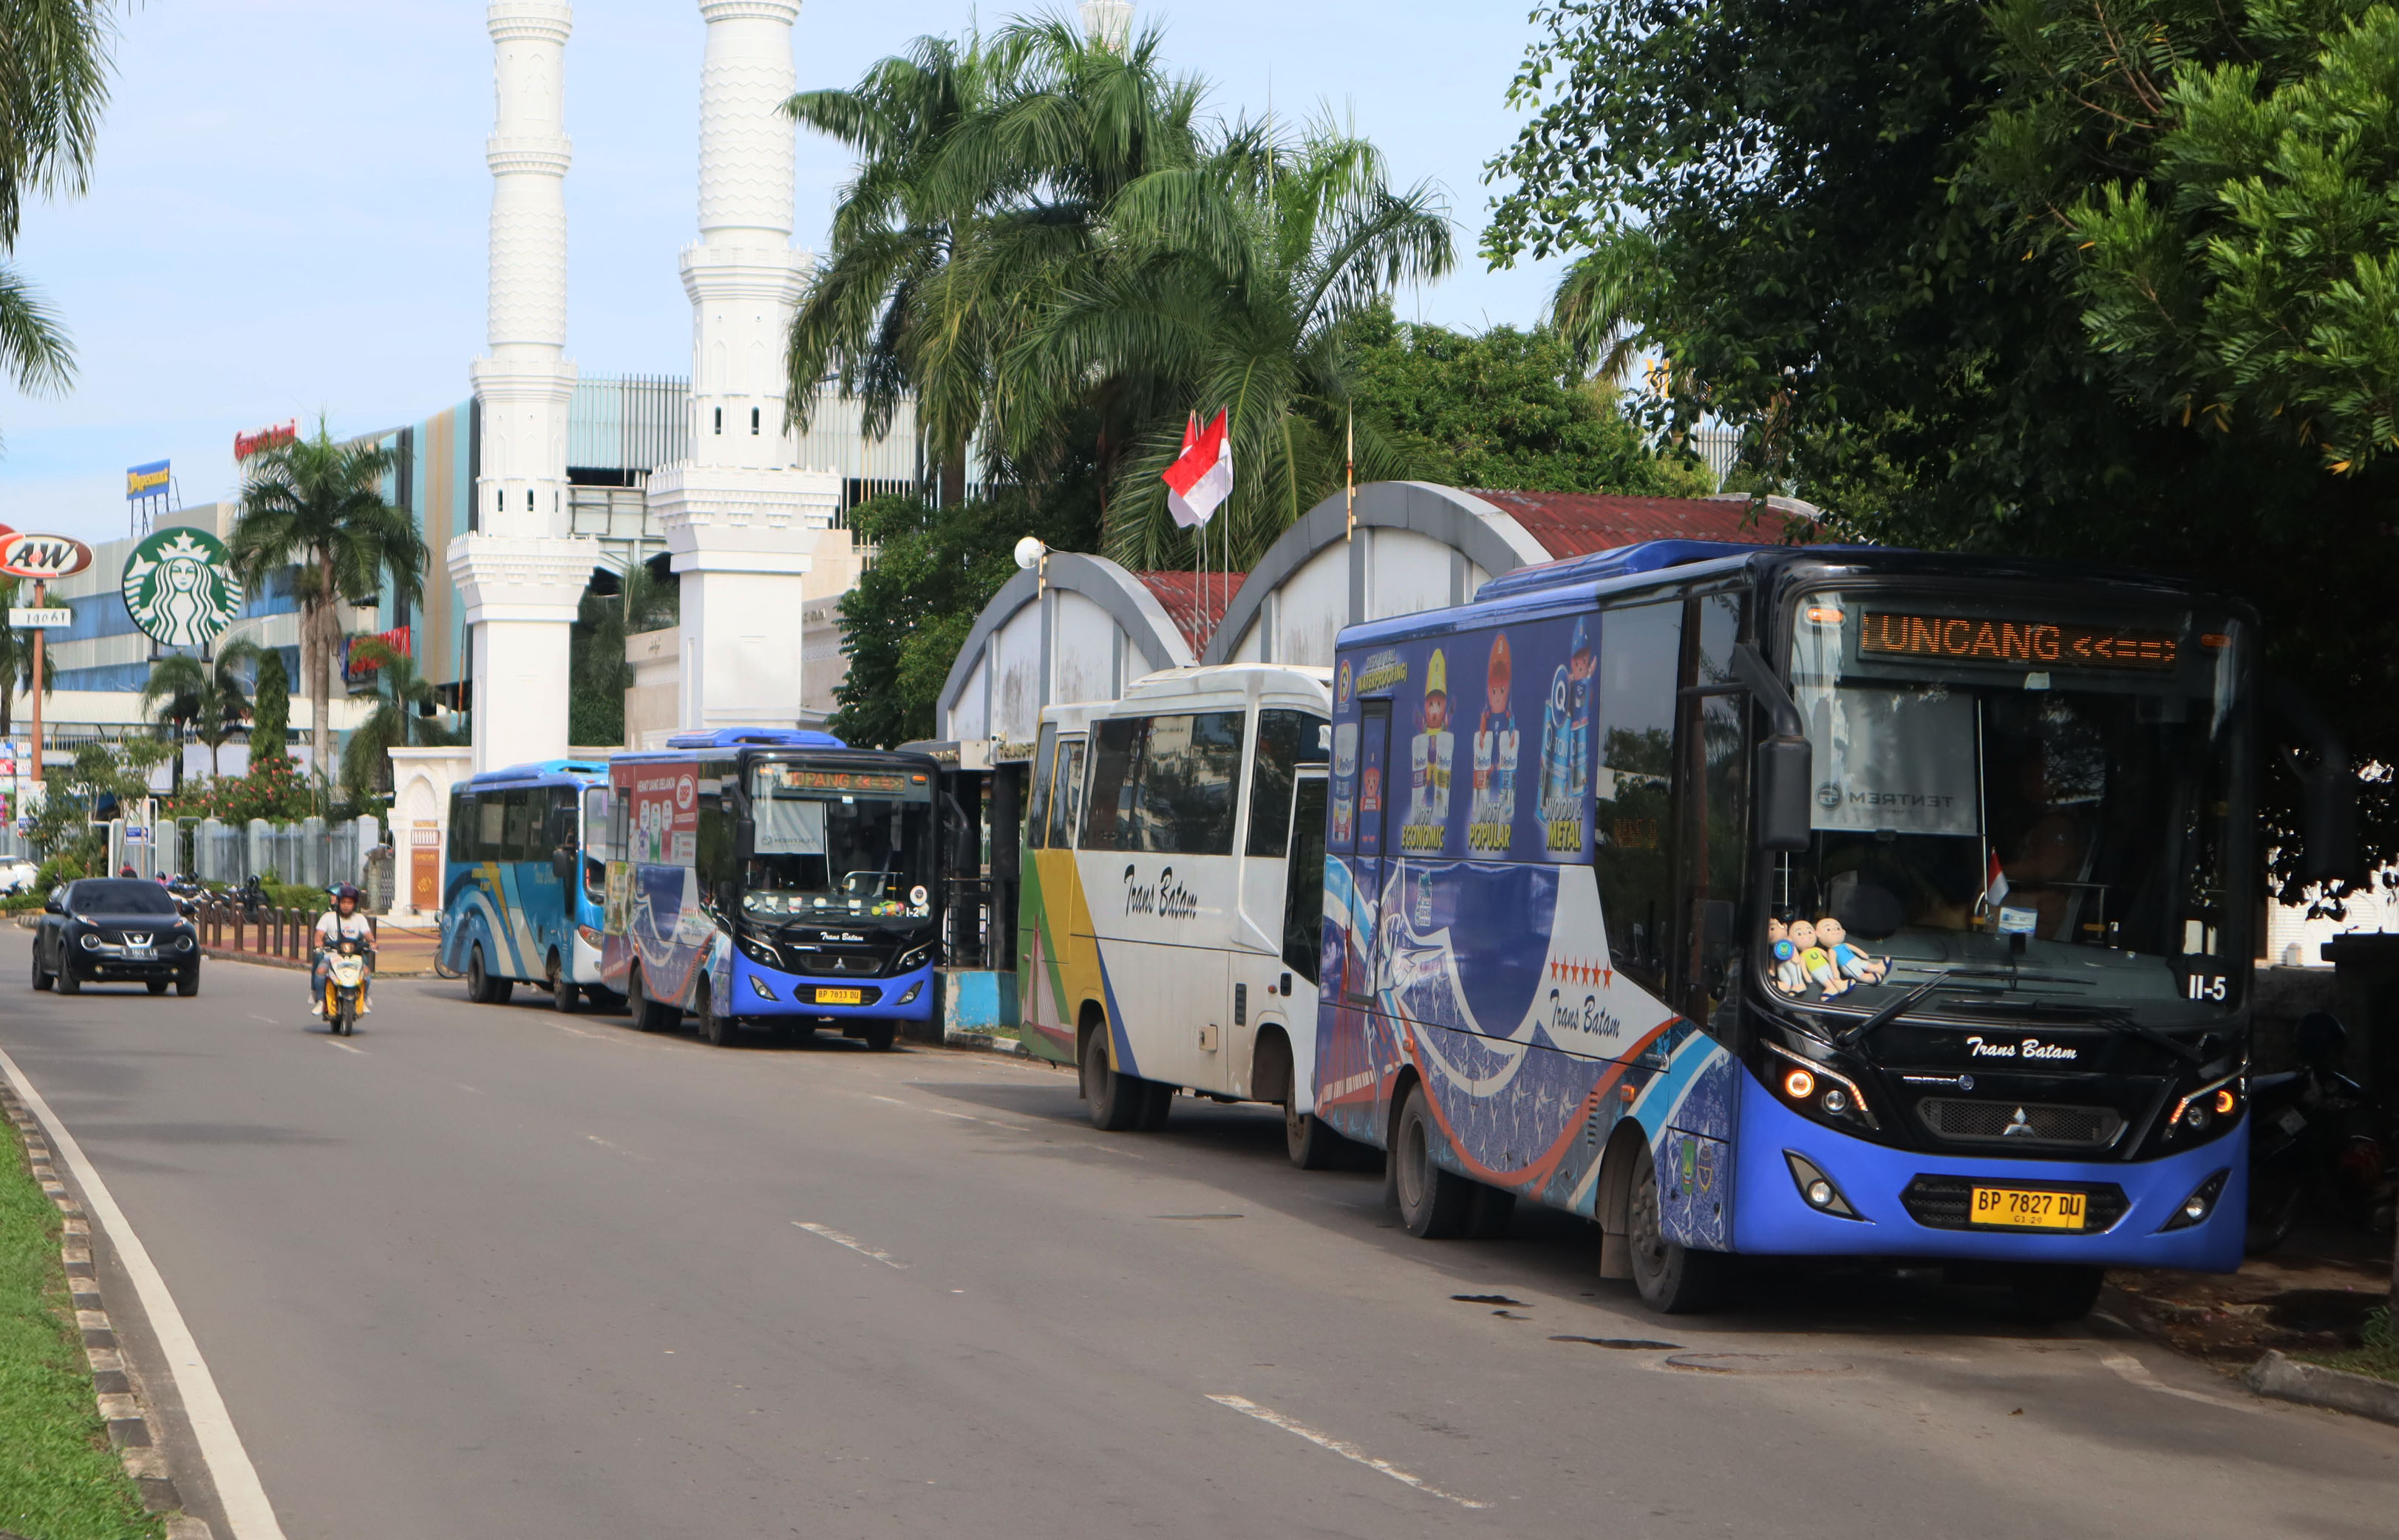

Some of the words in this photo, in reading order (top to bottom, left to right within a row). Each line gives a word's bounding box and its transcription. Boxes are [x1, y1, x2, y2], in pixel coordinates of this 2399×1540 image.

[7, 542, 78, 569] A&W
[1882, 615, 2061, 661] UNCANG
[1555, 679, 1566, 712] Q
[1415, 806, 1432, 825] MOST
[1479, 802, 1501, 823] MOST
[1545, 797, 1573, 820] WOOD
[1401, 824, 1446, 851] ECONOMIC
[1468, 821, 1511, 851] POPULAR
[1546, 820, 1582, 852] METAL
[1124, 863, 1154, 917] Trans
[1159, 865, 1197, 920] Batam
[820, 931, 840, 941] Trans
[841, 932, 864, 942] Batam
[2189, 974, 2227, 1001] II-5
[1549, 988, 1579, 1031] Trans
[1583, 995, 1620, 1039] Batam
[1966, 1036, 2017, 1057] Trans
[2021, 1038, 2078, 1060] Batam
[1978, 1190, 2001, 1210] BP
[2010, 1193, 2052, 1215] 7827
[2059, 1196, 2081, 1216] DU
